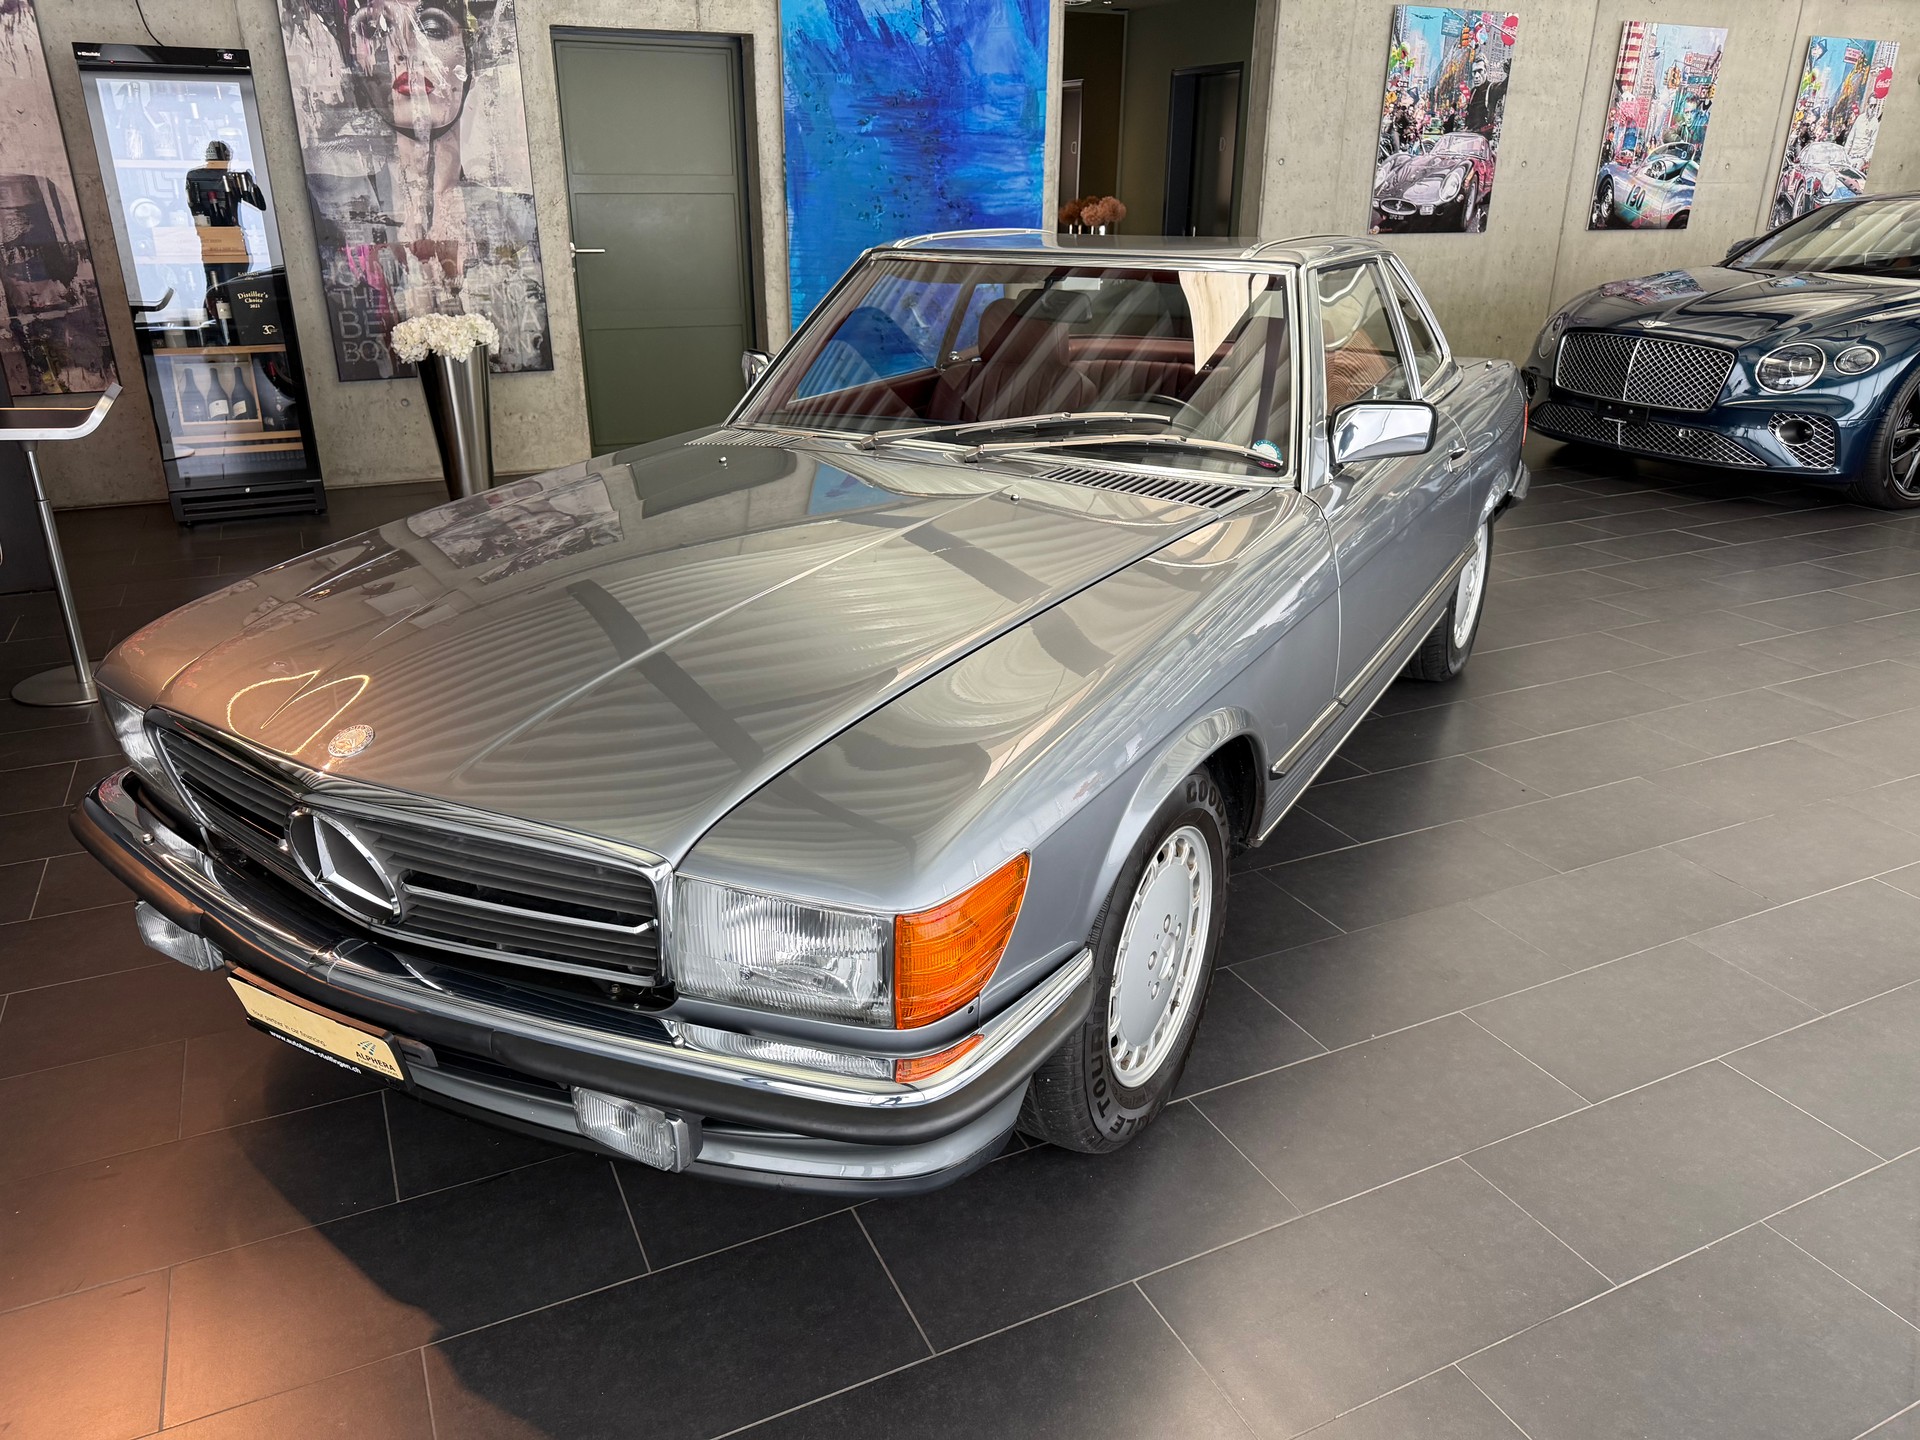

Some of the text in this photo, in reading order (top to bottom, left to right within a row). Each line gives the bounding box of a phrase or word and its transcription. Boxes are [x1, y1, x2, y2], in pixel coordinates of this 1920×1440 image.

[1626, 184, 1646, 211] 130
[237, 291, 269, 300] Distiller's
[355, 1051, 396, 1072] ALPHERA
